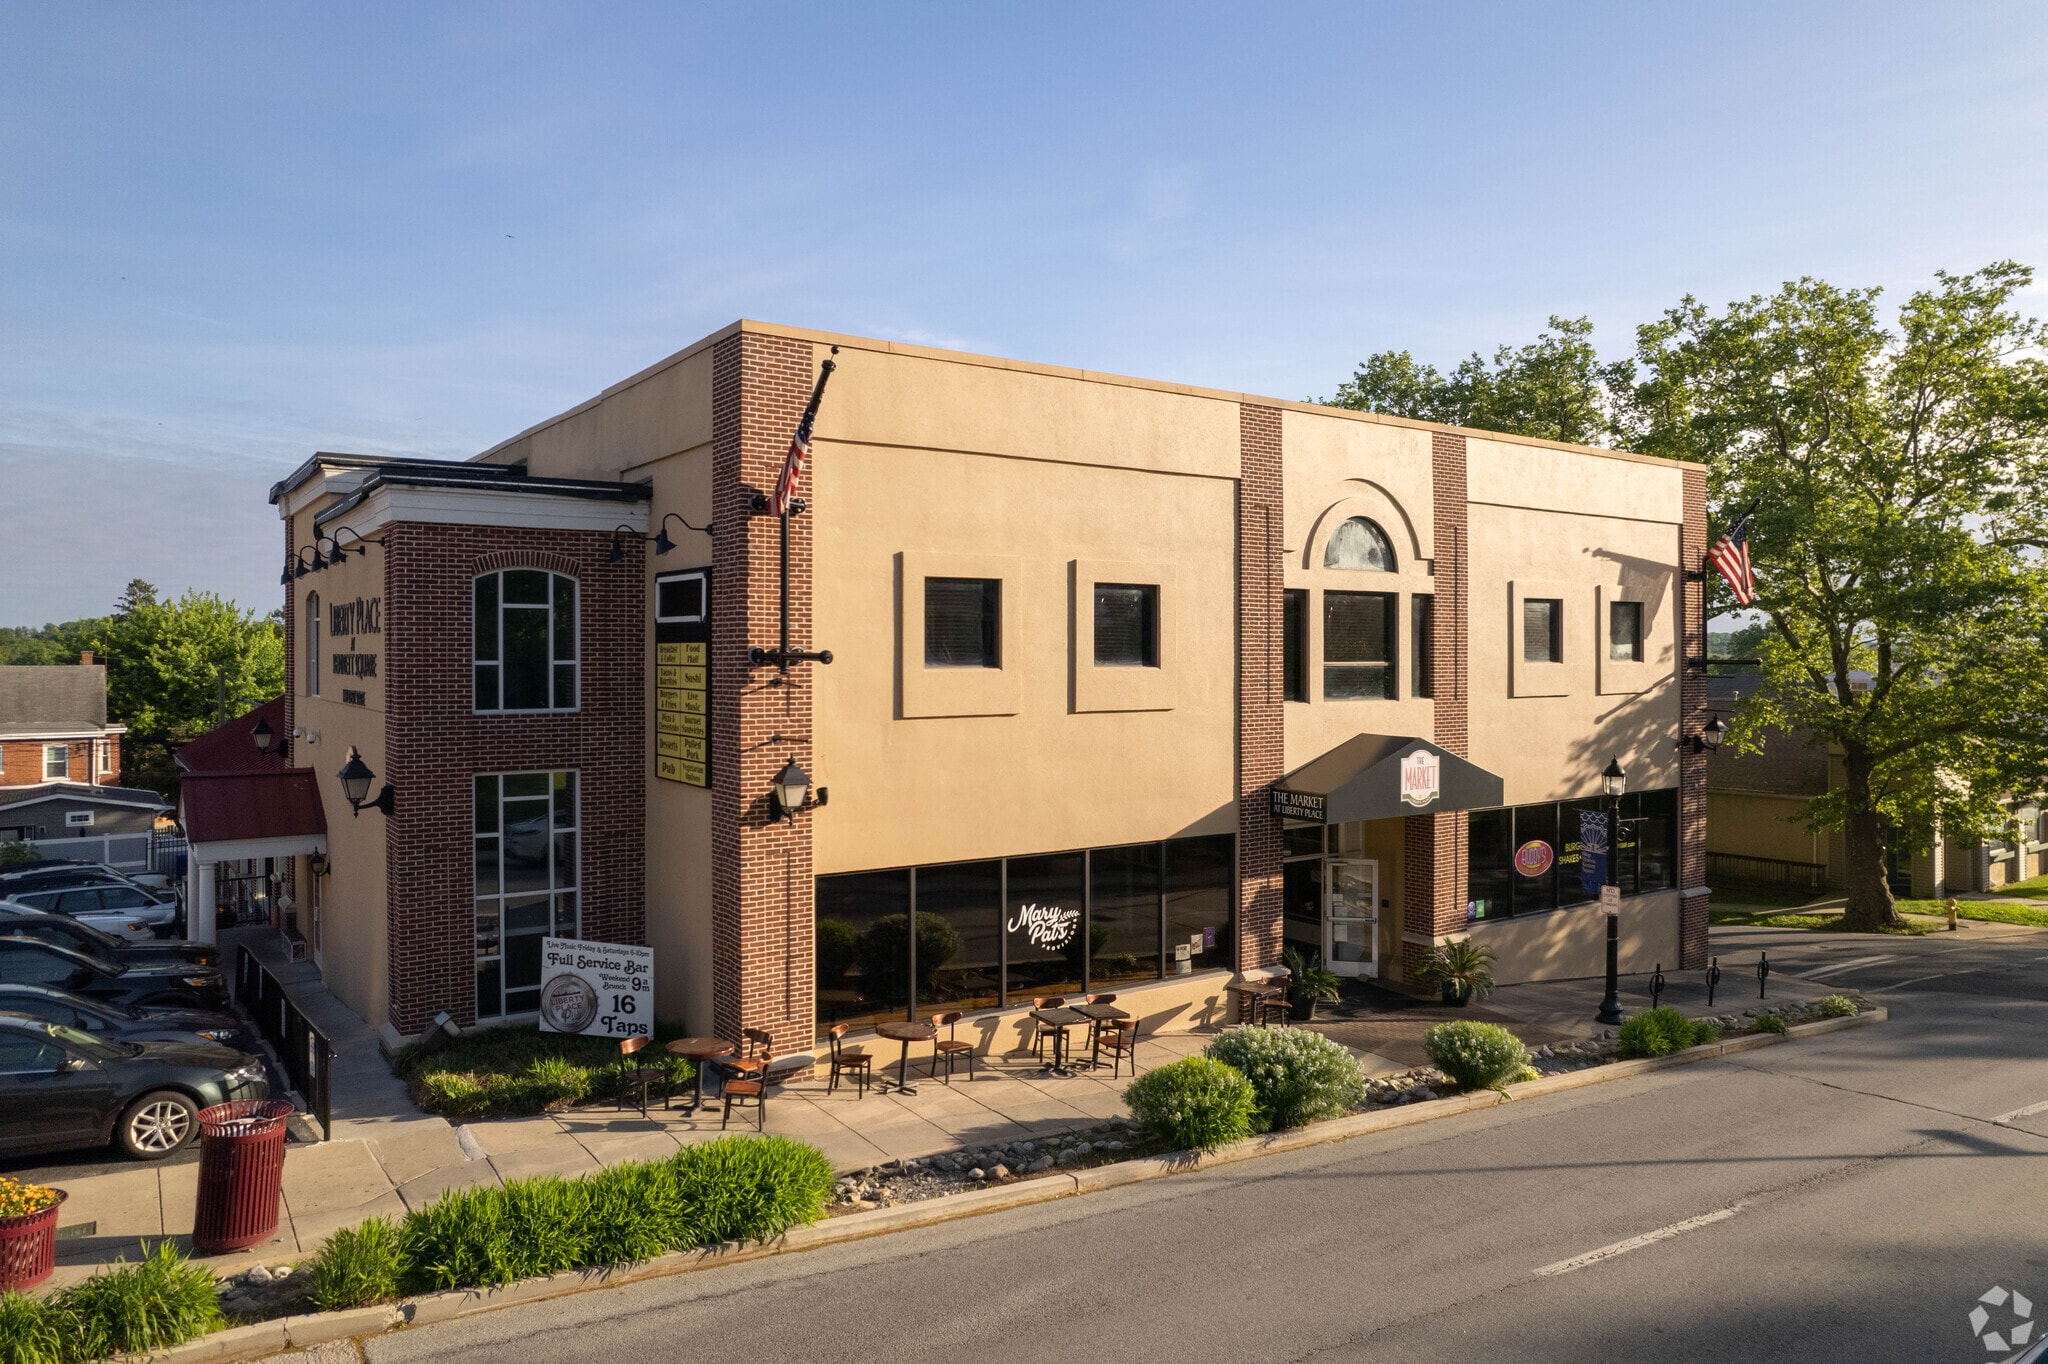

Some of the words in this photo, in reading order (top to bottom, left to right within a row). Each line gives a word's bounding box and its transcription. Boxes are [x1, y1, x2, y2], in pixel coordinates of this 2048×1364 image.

[329, 602, 355, 636] LIBERTY
[356, 597, 381, 635] PLACE
[685, 644, 701, 653] Food
[686, 655, 699, 663] Hall
[660, 668, 673, 676] Tacos
[684, 673, 701, 683] Sushi
[659, 690, 678, 699] Burgers
[687, 692, 699, 700] Live
[665, 700, 677, 709] Fries
[685, 702, 701, 712] Music
[659, 738, 679, 751] Desserts
[684, 738, 702, 750] Pulled
[686, 749, 700, 760] Pork
[662, 762, 676, 775] Pub
[1405, 766, 1437, 791] MARKET
[1272, 791, 1289, 804] THE
[1290, 793, 1324, 809] MARKET
[1273, 804, 1281, 813] AT
[1281, 805, 1304, 817] LIBERTY
[1304, 808, 1324, 819] PLACE
[1564, 841, 1581, 852] BURG
[1007, 903, 1061, 933] Mary
[546, 940, 560, 949] Live
[560, 941, 577, 950] Music
[577, 943, 596, 953] Friday
[597, 946, 602, 954] &
[602, 946, 629, 956] Saturdays
[630, 949, 650, 958] 6-10pm
[547, 952, 574, 966] Full
[577, 955, 621, 970] Service
[624, 960, 649, 975] Bar
[598, 973, 630, 983] Weekend
[631, 977, 642, 991] 9
[602, 981, 627, 990] Brunch
[551, 994, 585, 1006] LIBERTY
[612, 994, 636, 1014] 16
[555, 1002, 583, 1012] PLACE
[600, 1015, 648, 1037] Taps
